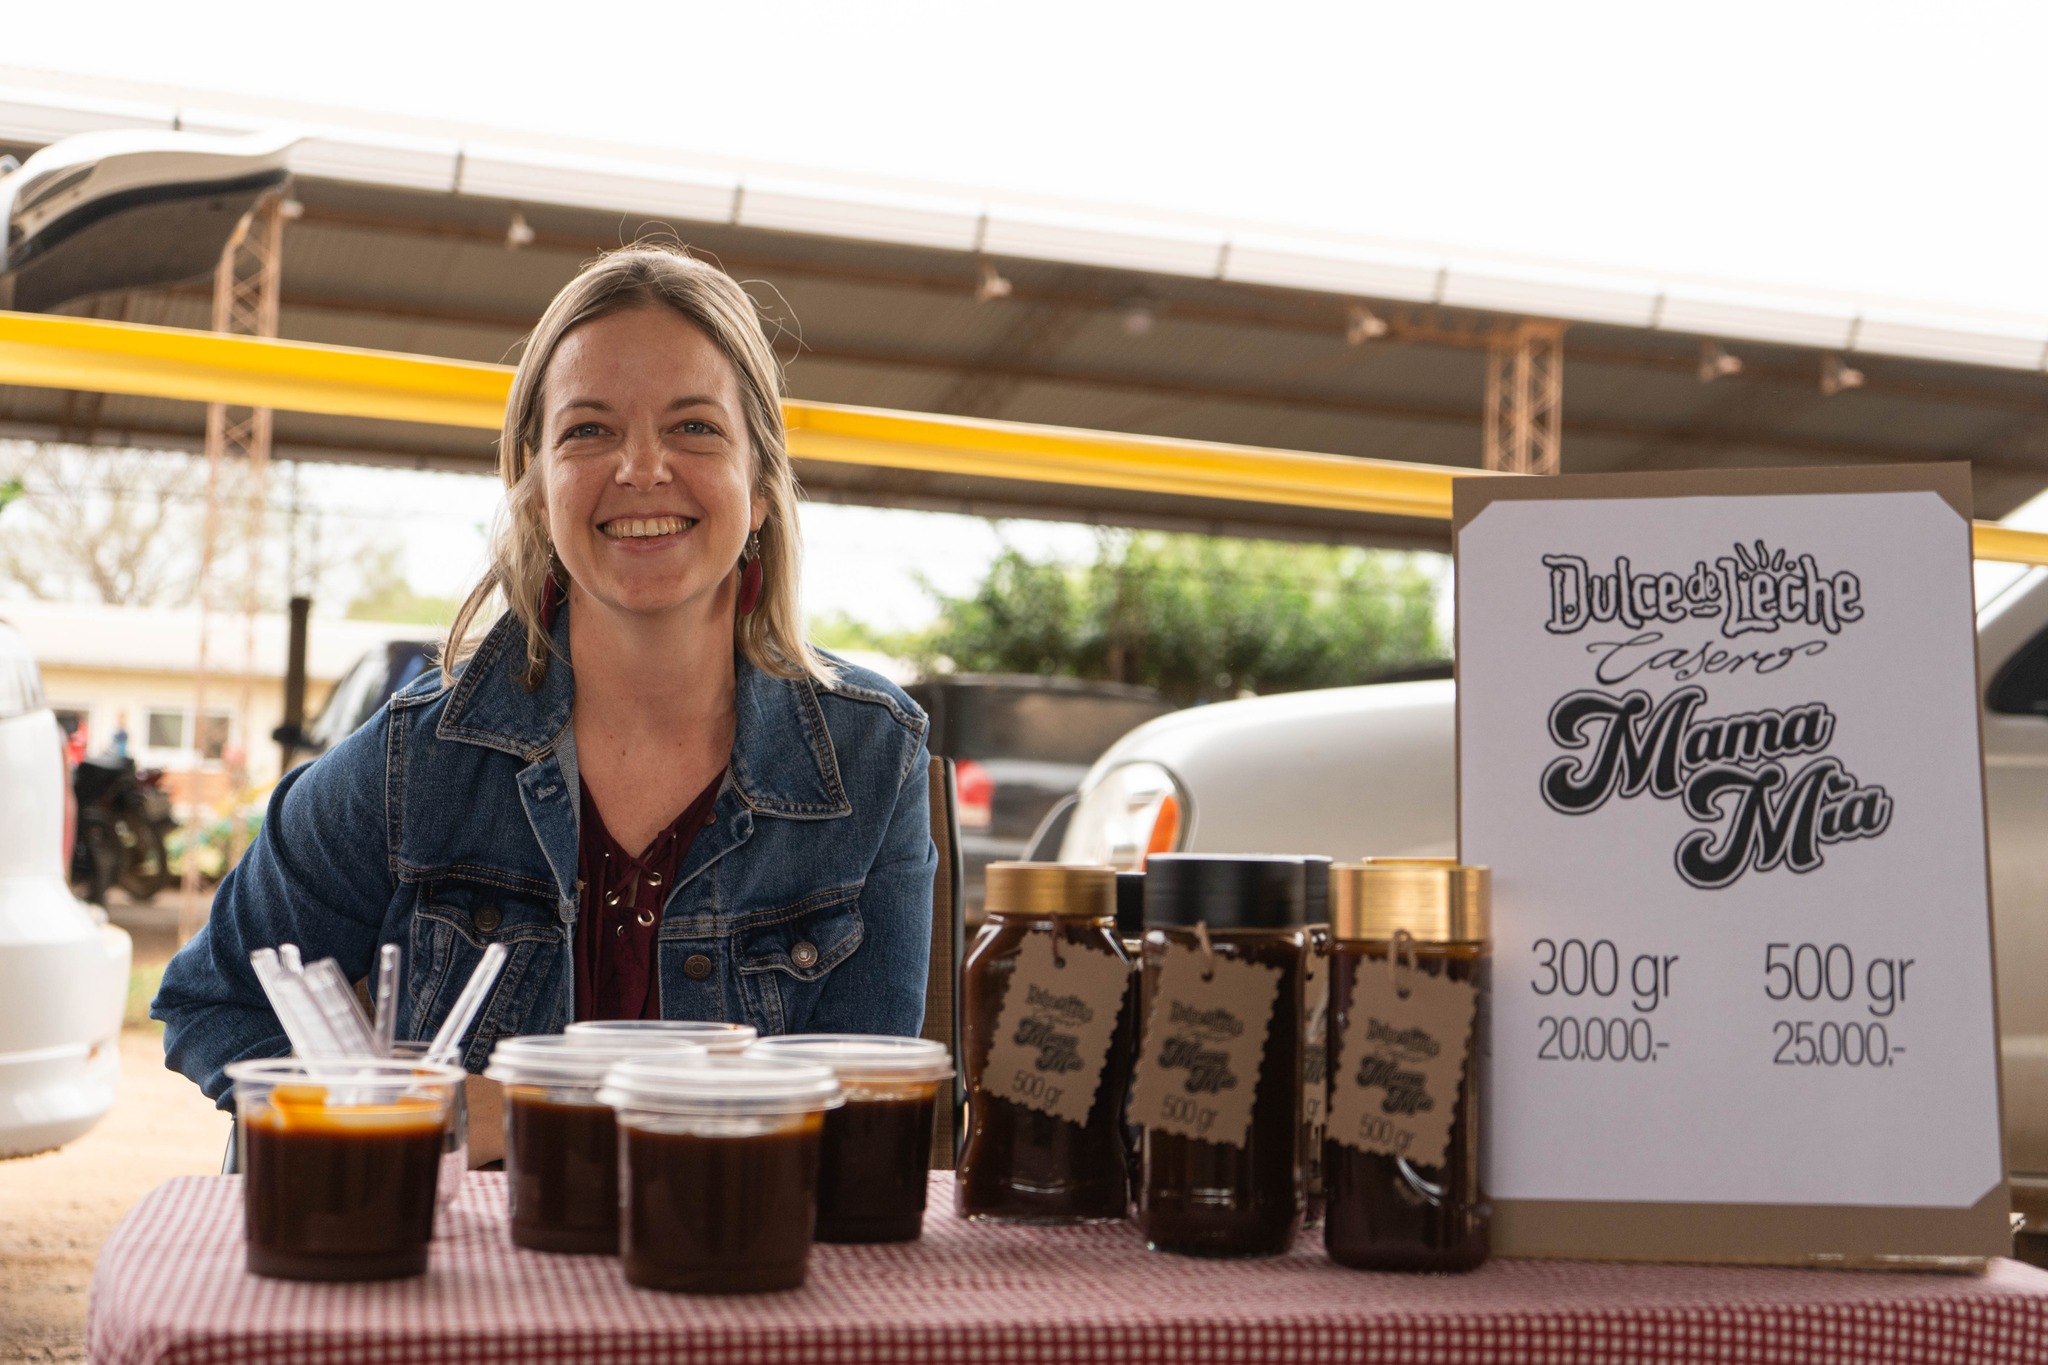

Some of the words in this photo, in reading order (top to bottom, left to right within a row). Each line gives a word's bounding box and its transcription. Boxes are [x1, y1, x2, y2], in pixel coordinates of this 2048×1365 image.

[1542, 554, 1687, 634] Dulce
[1685, 561, 1723, 610] de
[1716, 553, 1864, 638] Leche
[1586, 632, 1828, 686] Casero
[1540, 685, 1836, 816] Mama
[1530, 937, 1619, 997] 300
[1630, 953, 1680, 1013] gr
[1764, 943, 1855, 1001] 500
[1866, 957, 1916, 1018] gr
[1011, 1069, 1046, 1099] 500
